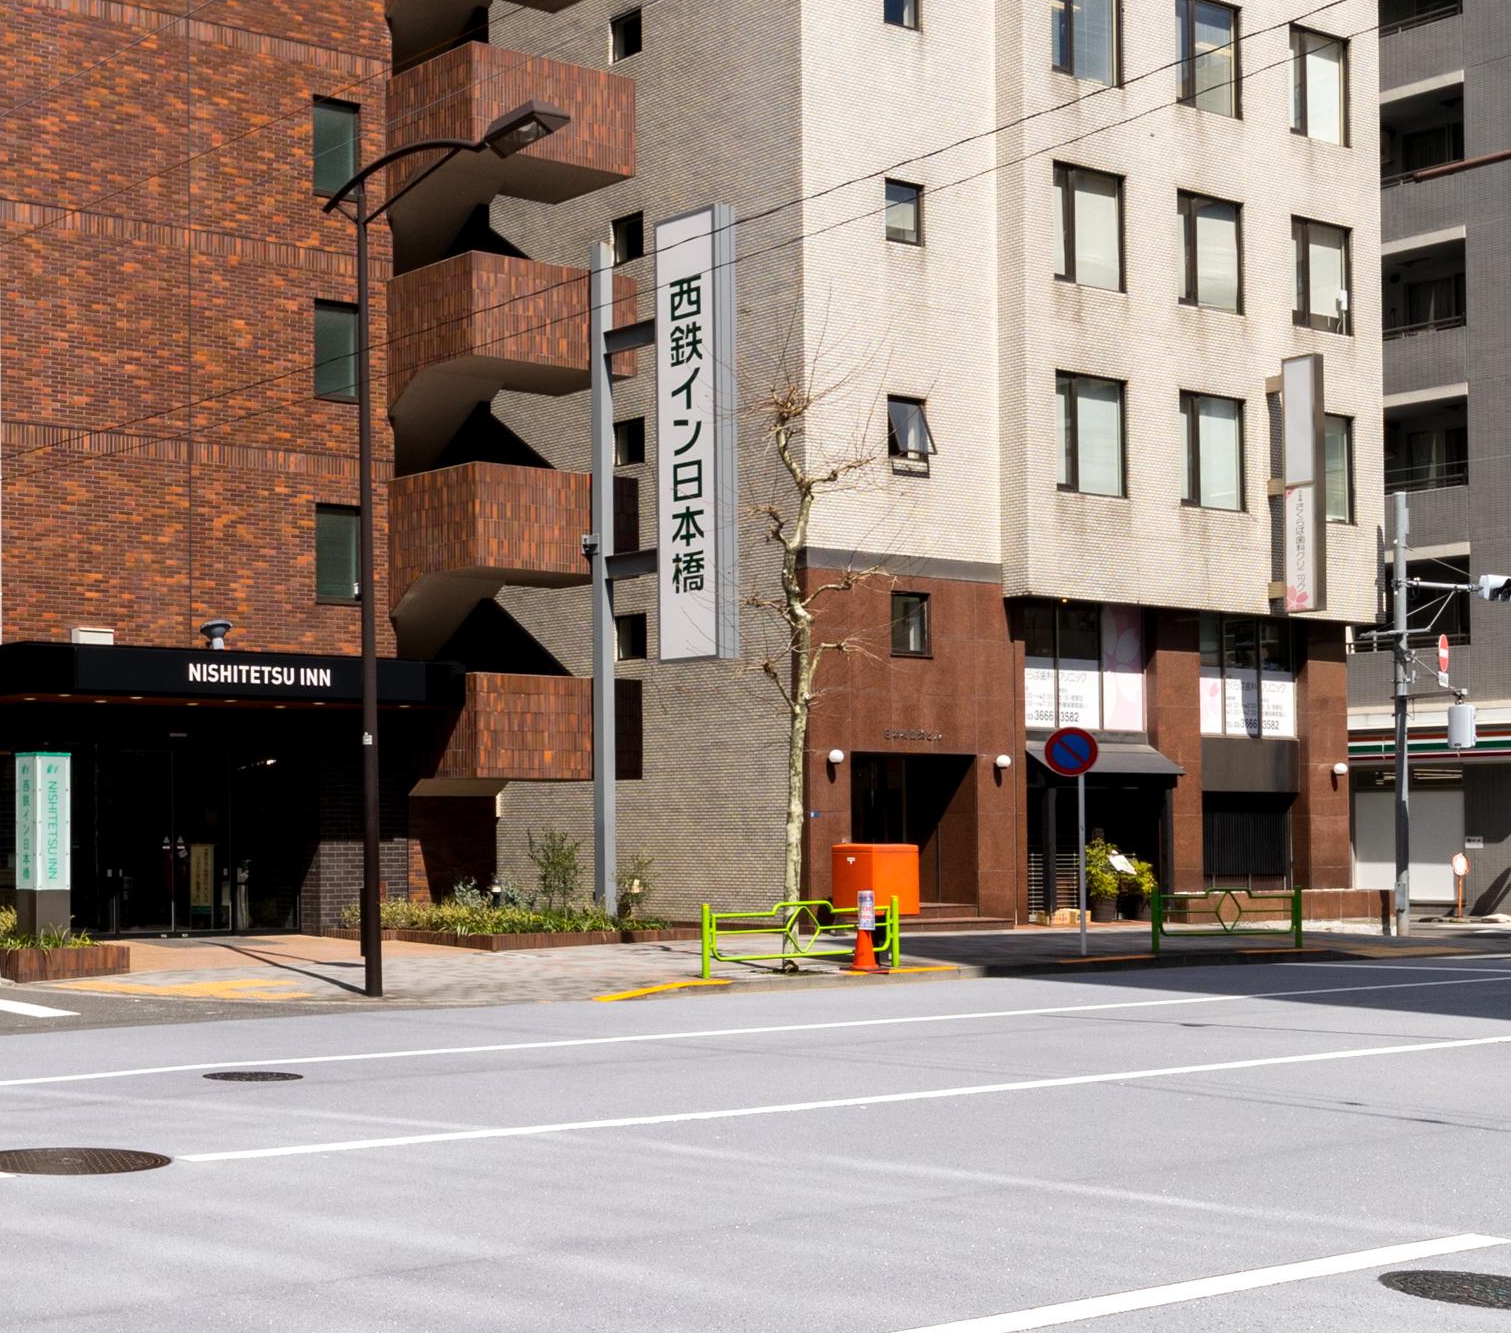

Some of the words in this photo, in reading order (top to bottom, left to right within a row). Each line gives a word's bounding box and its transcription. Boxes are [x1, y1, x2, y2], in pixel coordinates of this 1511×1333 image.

[669, 274, 705, 594] 西鉄イン日本橋
[188, 662, 296, 686] NISHITETSU
[299, 666, 332, 687] INN
[23, 780, 31, 880] 西鉄イン日本橋
[48, 780, 59, 856] NISHITETSU
[48, 858, 58, 880] INN
